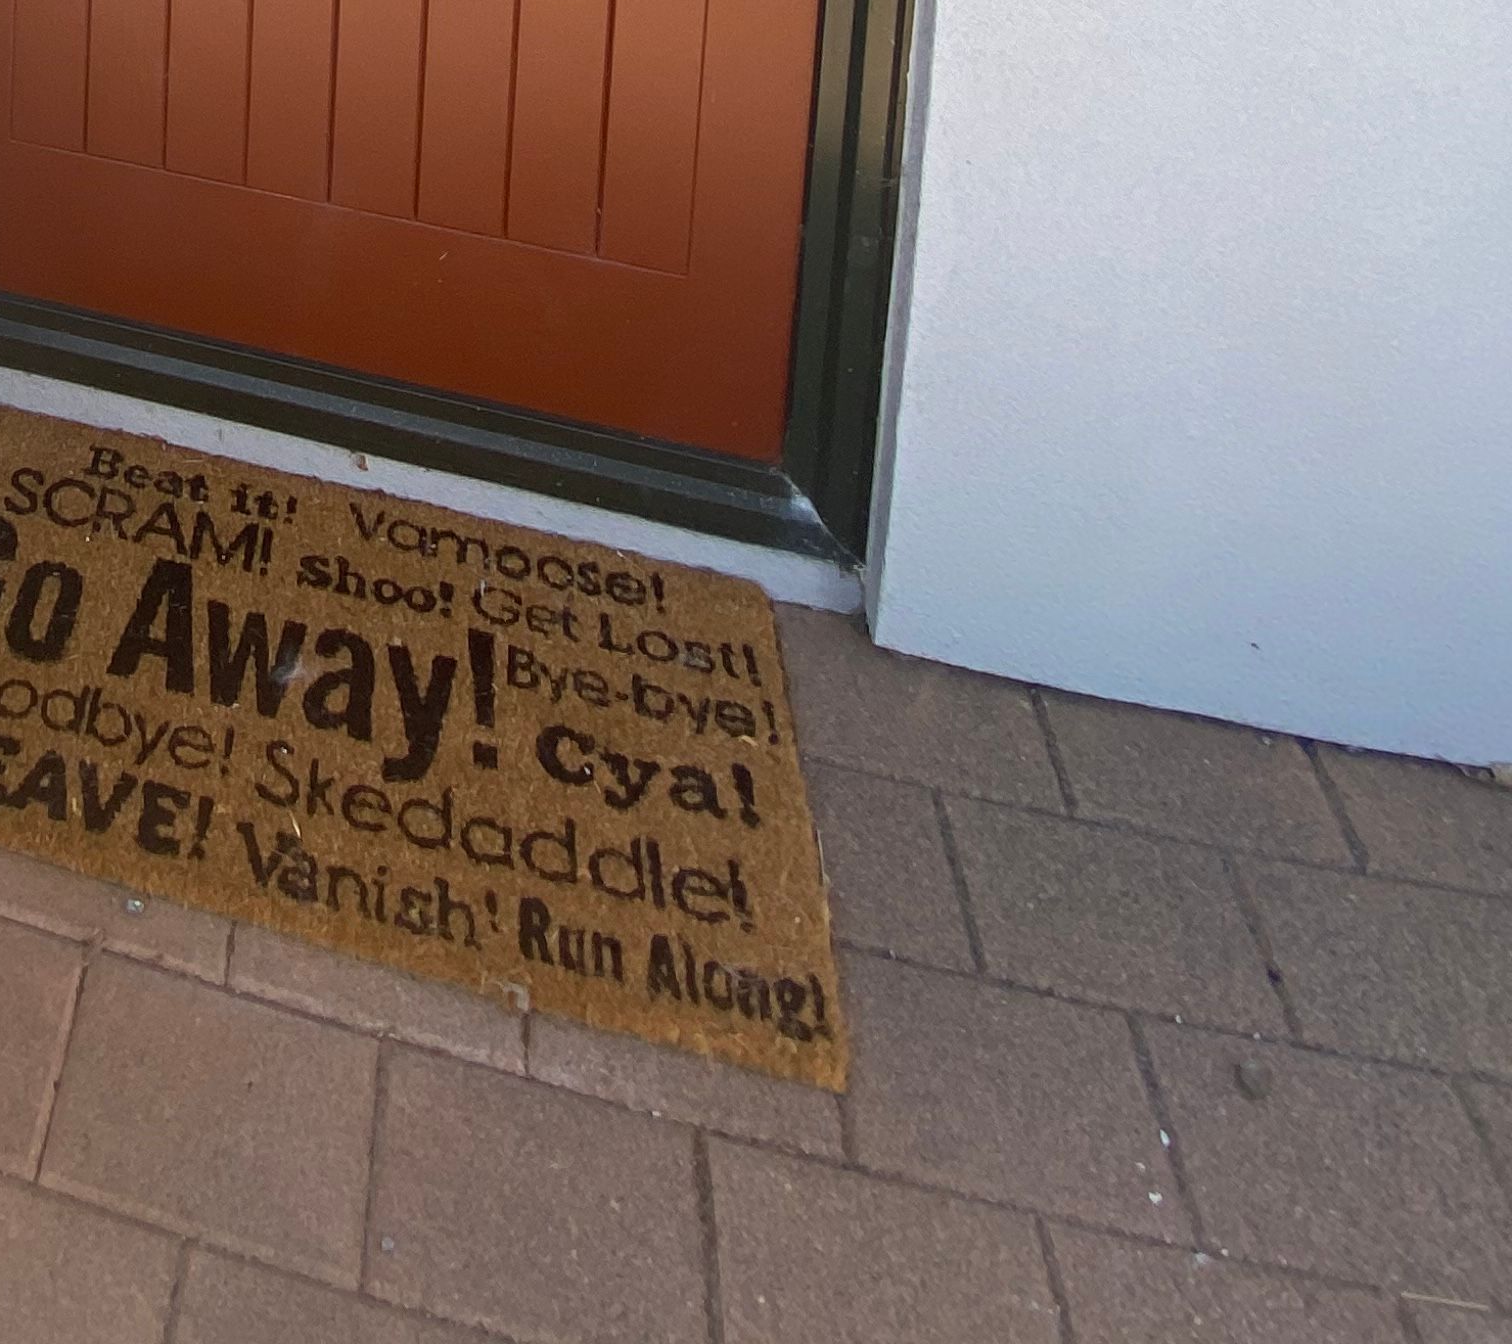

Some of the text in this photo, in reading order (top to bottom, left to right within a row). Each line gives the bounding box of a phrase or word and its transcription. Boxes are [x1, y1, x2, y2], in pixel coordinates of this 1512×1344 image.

[3, 467, 274, 576] SCRAM!
[86, 444, 209, 504] Beat
[349, 502, 666, 612] Vamoose!
[105, 557, 499, 784] Away!
[472, 585, 763, 687] Get Lost!
[236, 821, 502, 950] Vanish!
[254, 740, 756, 934] Skedaddle!
[518, 895, 833, 1043] Run Along!
